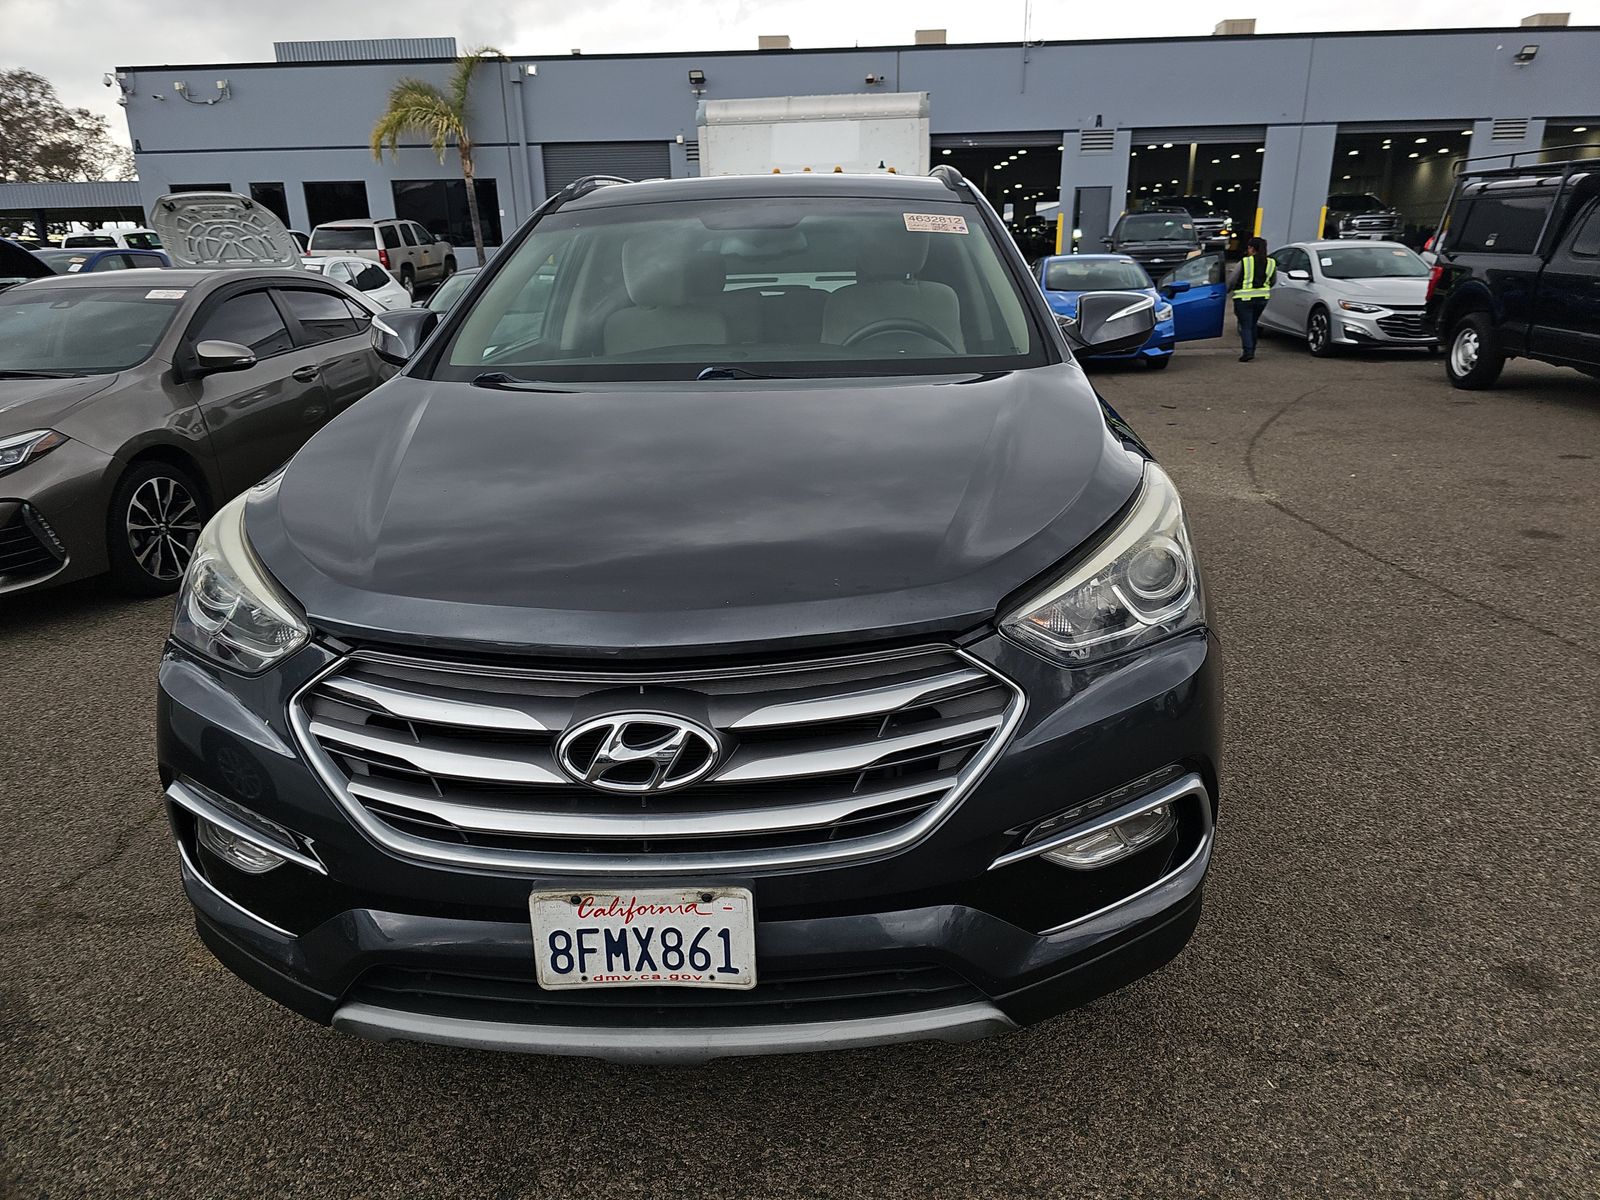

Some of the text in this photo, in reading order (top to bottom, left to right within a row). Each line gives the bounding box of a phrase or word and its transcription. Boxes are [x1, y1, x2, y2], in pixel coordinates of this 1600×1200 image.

[908, 215, 962, 224] 4632812
[577, 896, 713, 924] California
[549, 927, 739, 974] 8FMX861
[593, 974, 702, 982] dmv.ca.gov
